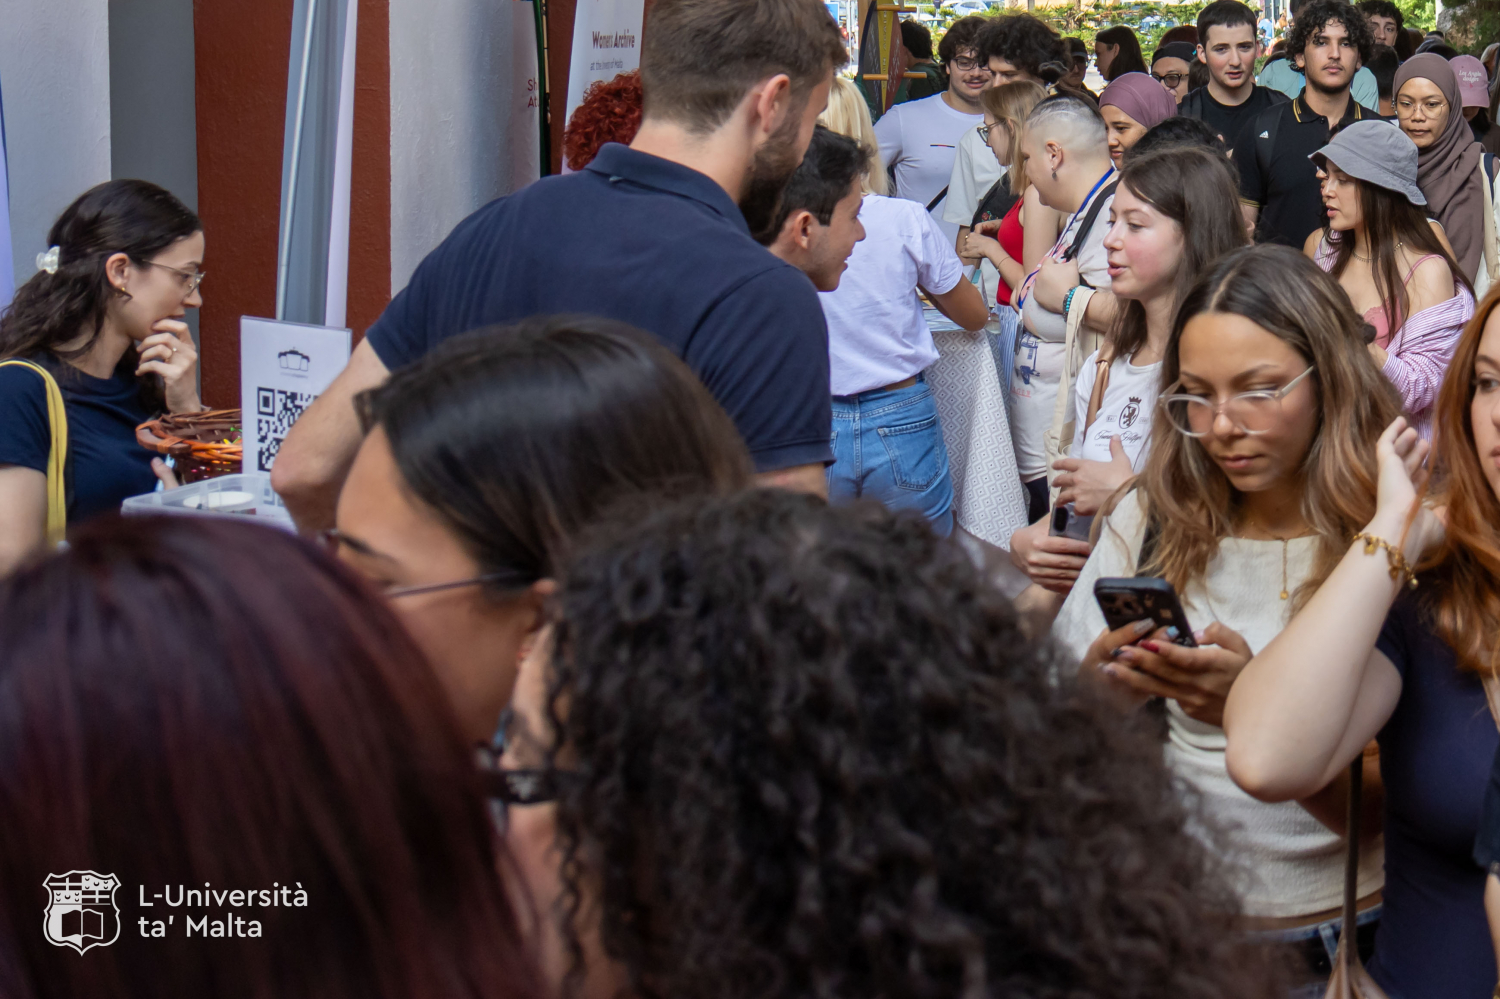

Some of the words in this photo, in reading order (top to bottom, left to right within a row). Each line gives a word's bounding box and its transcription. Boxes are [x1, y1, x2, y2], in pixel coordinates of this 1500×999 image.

[613, 28, 635, 49] Archive
[527, 77, 539, 92] Sh
[527, 95, 540, 108] At
